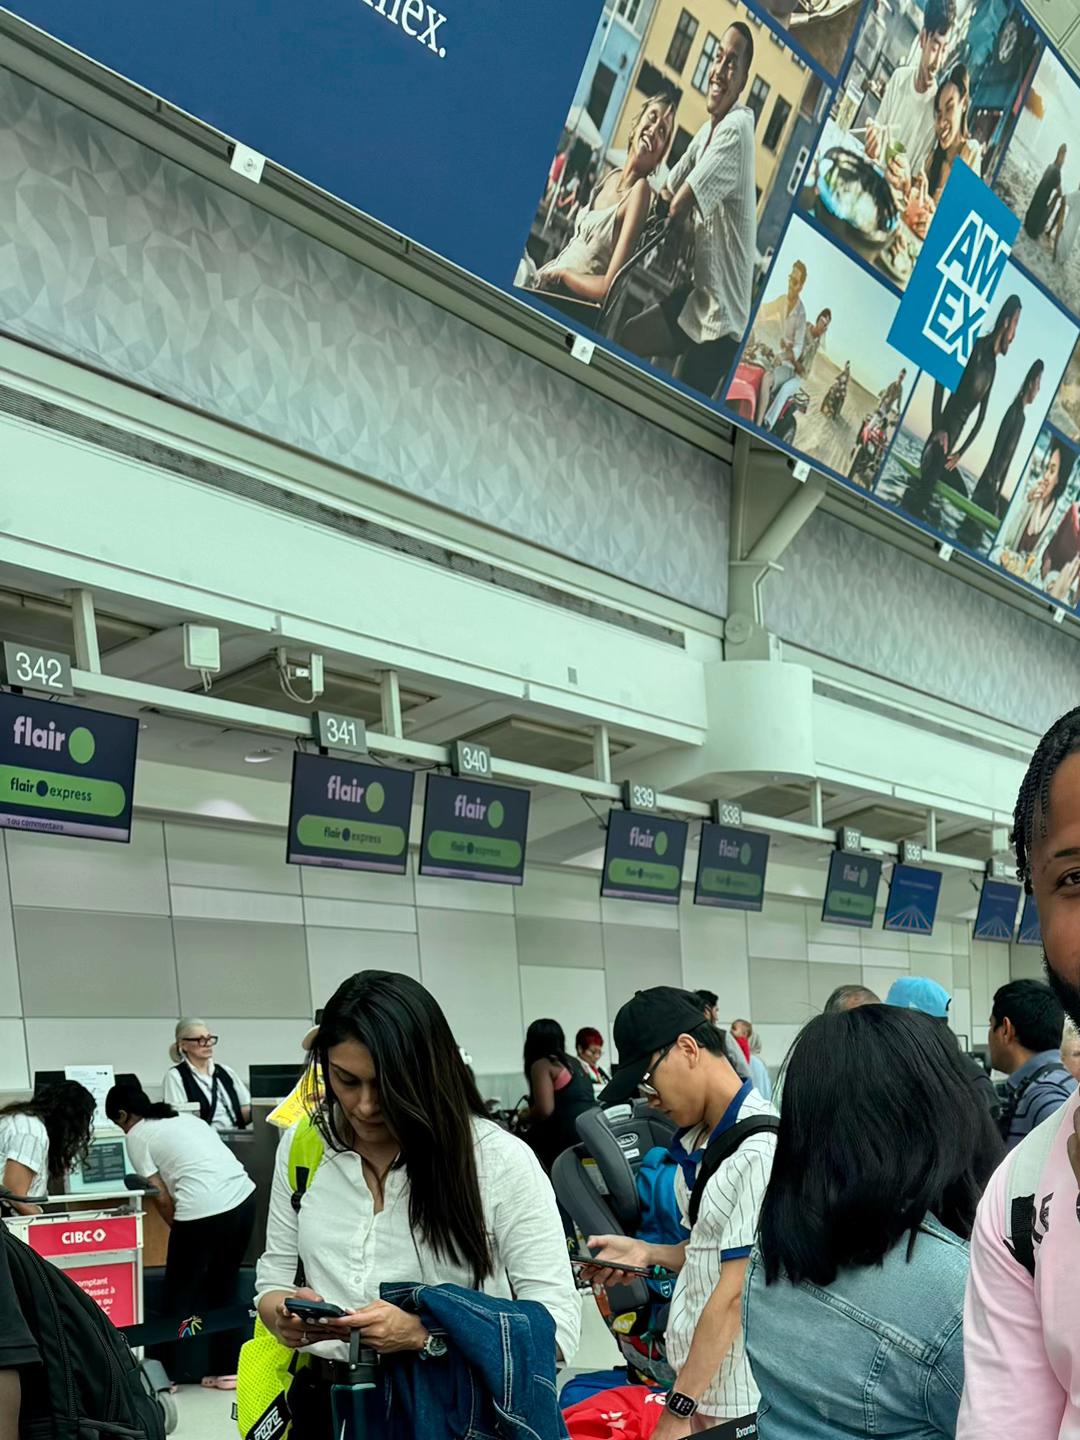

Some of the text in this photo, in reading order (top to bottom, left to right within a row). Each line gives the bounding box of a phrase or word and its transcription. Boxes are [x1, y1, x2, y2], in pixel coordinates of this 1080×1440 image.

[15, 651, 64, 689] 342
[13, 716, 66, 752] flair
[326, 718, 358, 746] 341
[462, 747, 488, 773] 340
[10, 777, 92, 802] flair express
[327, 775, 365, 803] flair
[633, 786, 655, 808] 339
[454, 794, 488, 821] flair
[721, 804, 741, 825] 338
[629, 826, 656, 849] flair
[718, 839, 741, 859] flair
[61, 1230, 93, 1245] CIBC
[76, 1277, 109, 1288] omptant
